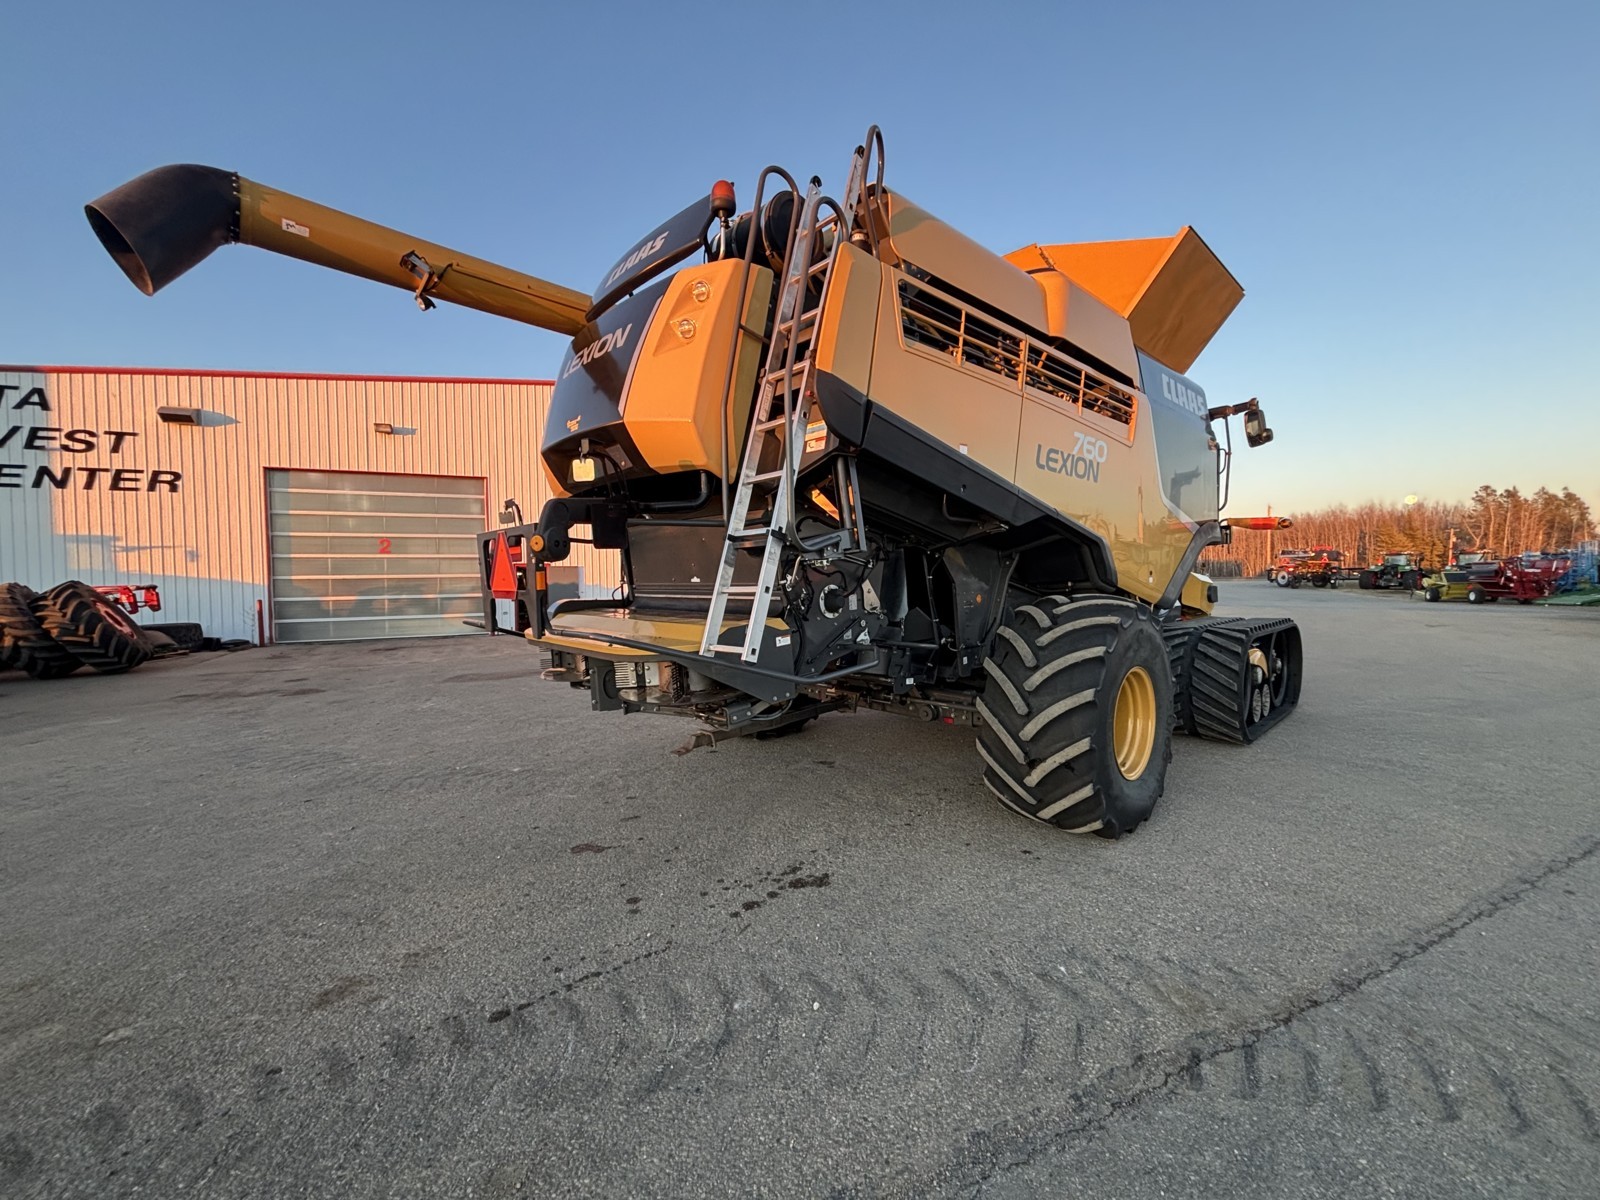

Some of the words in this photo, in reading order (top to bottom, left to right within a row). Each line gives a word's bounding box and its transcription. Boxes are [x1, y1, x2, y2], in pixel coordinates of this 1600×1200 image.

[605, 231, 669, 288] CLAAS
[563, 323, 632, 379] LEXION
[1161, 373, 1208, 416] CLAAS
[1036, 444, 1100, 483] LEXION
[1073, 431, 1107, 463] 760
[377, 538, 392, 555] 2
